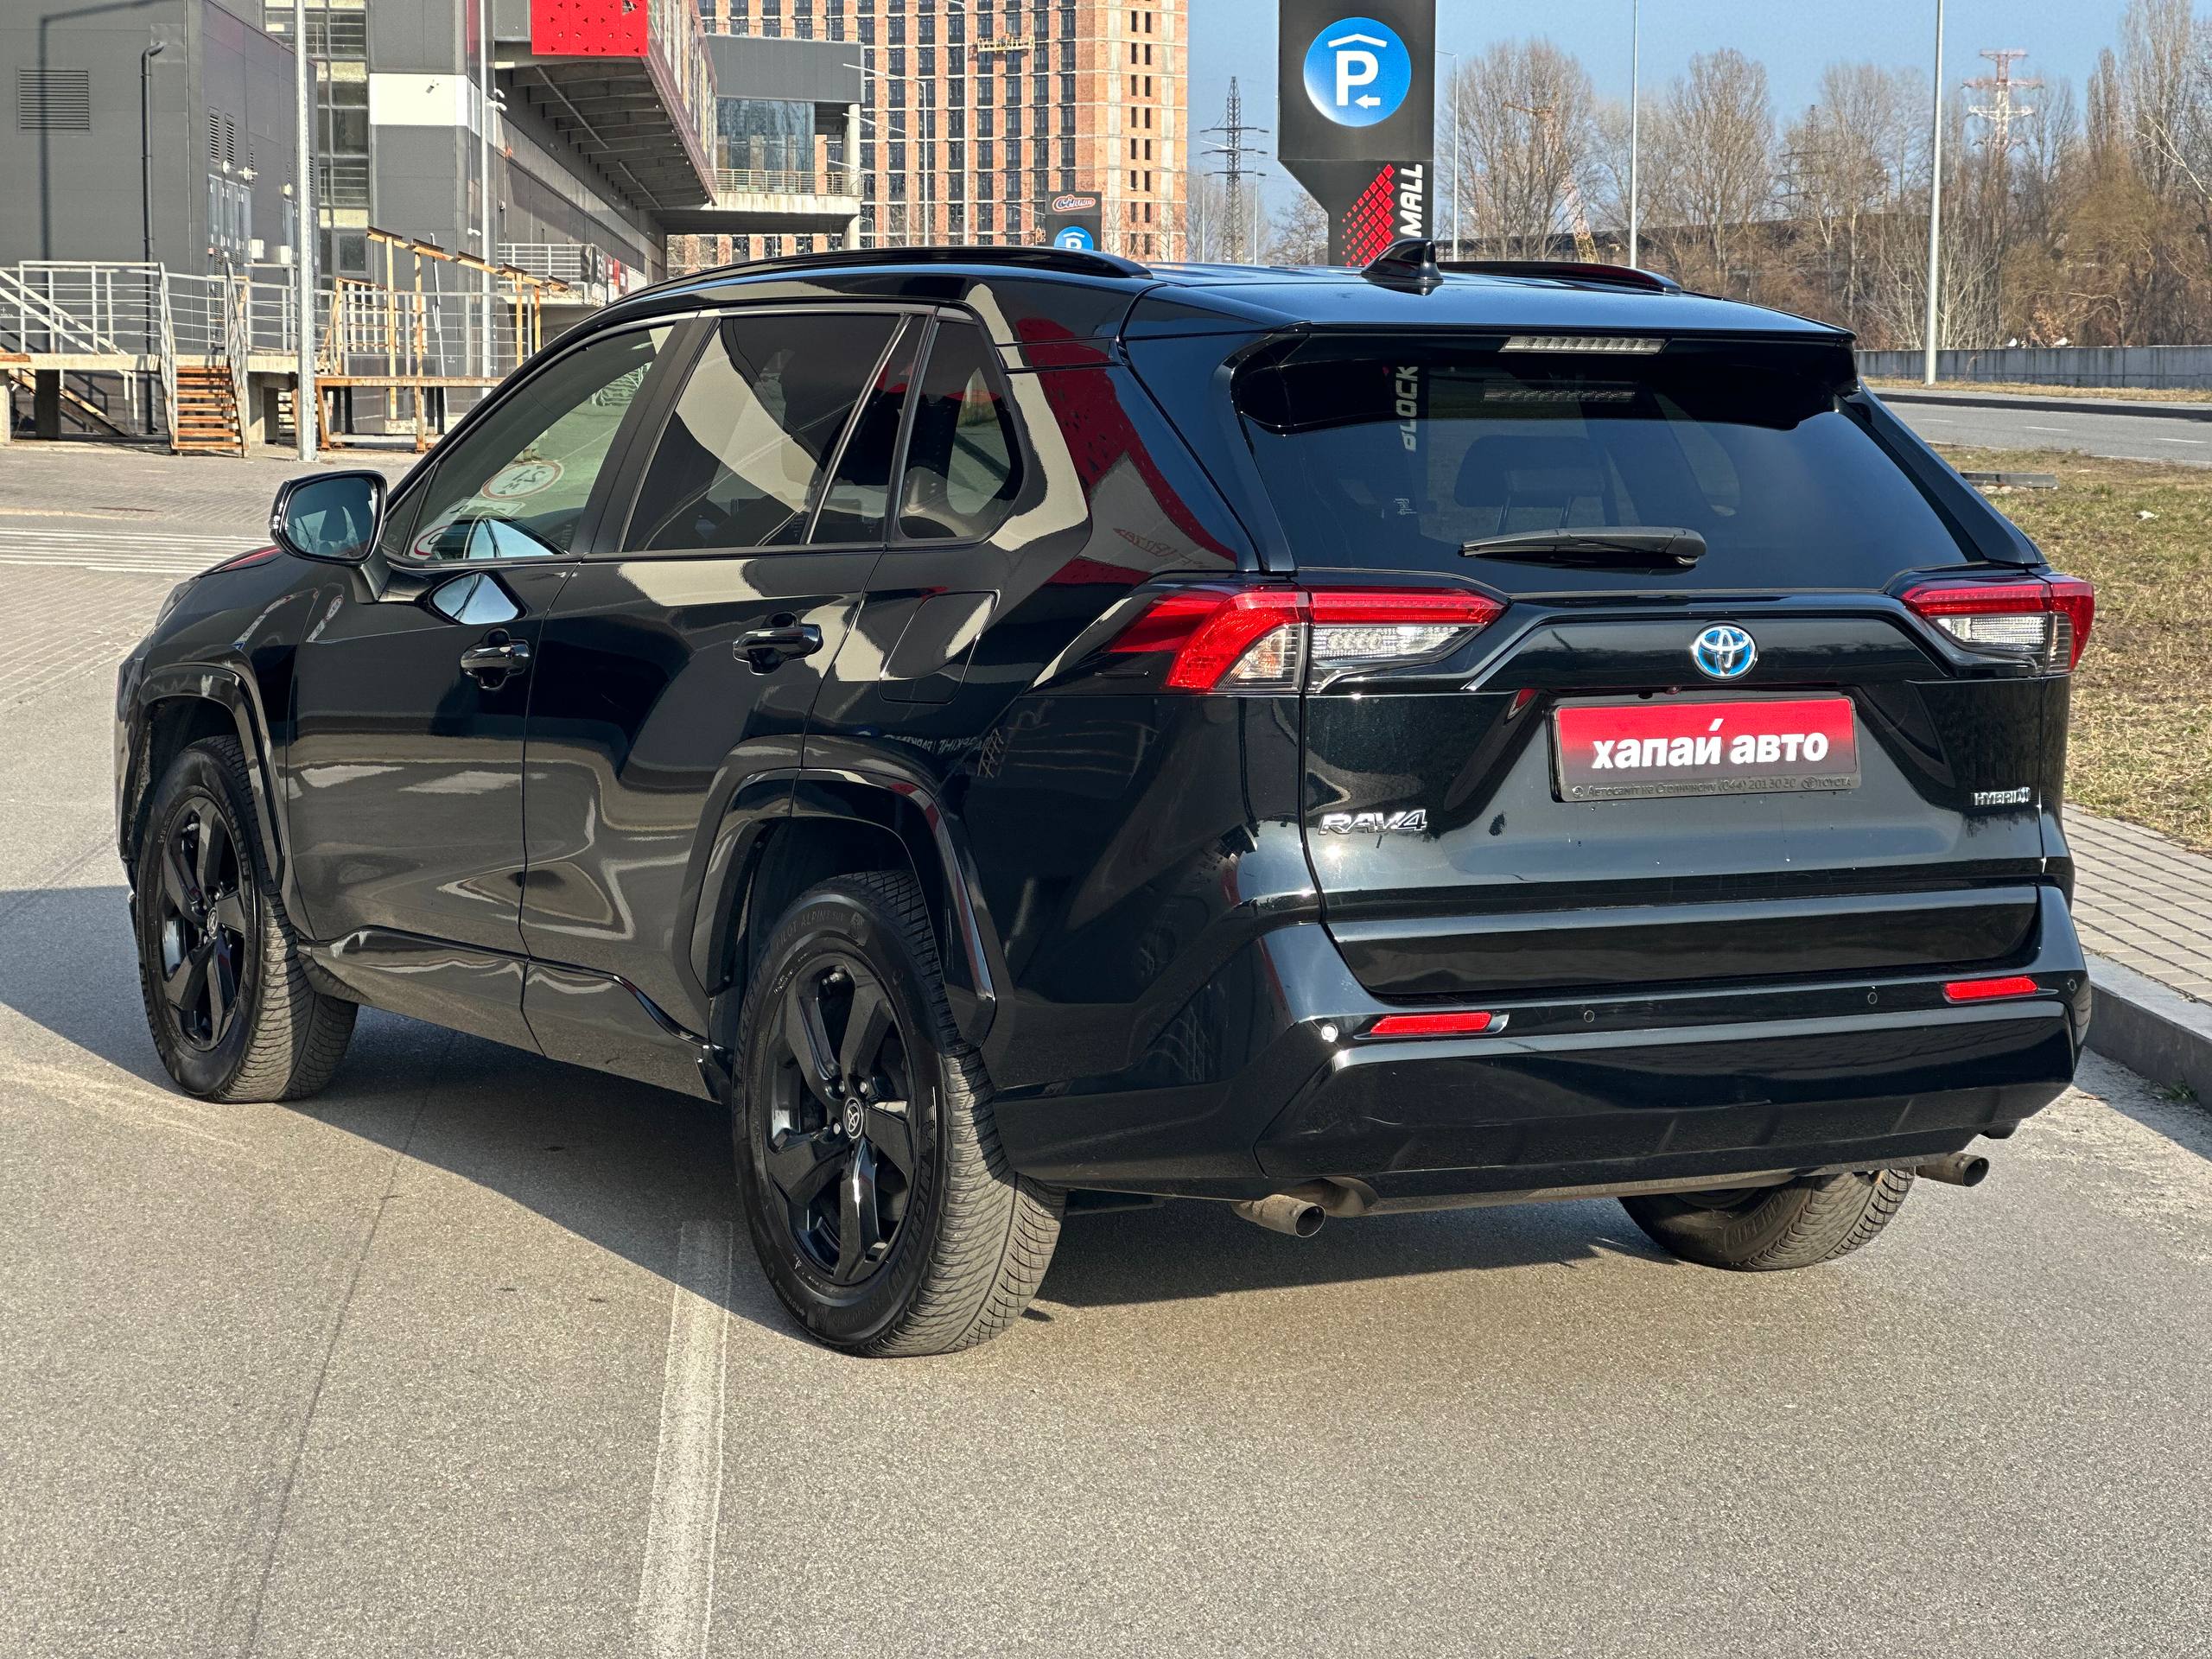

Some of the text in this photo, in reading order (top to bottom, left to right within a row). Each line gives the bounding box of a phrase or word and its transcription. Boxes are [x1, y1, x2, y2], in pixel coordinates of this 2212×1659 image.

[1336, 50, 1379, 106] P
[1400, 164, 1423, 238] MALL
[1730, 732, 1828, 765] авто
[1748, 779, 1768, 790] 201
[1974, 790, 2024, 806] HYBRID
[1319, 809, 1427, 836] RAV4
